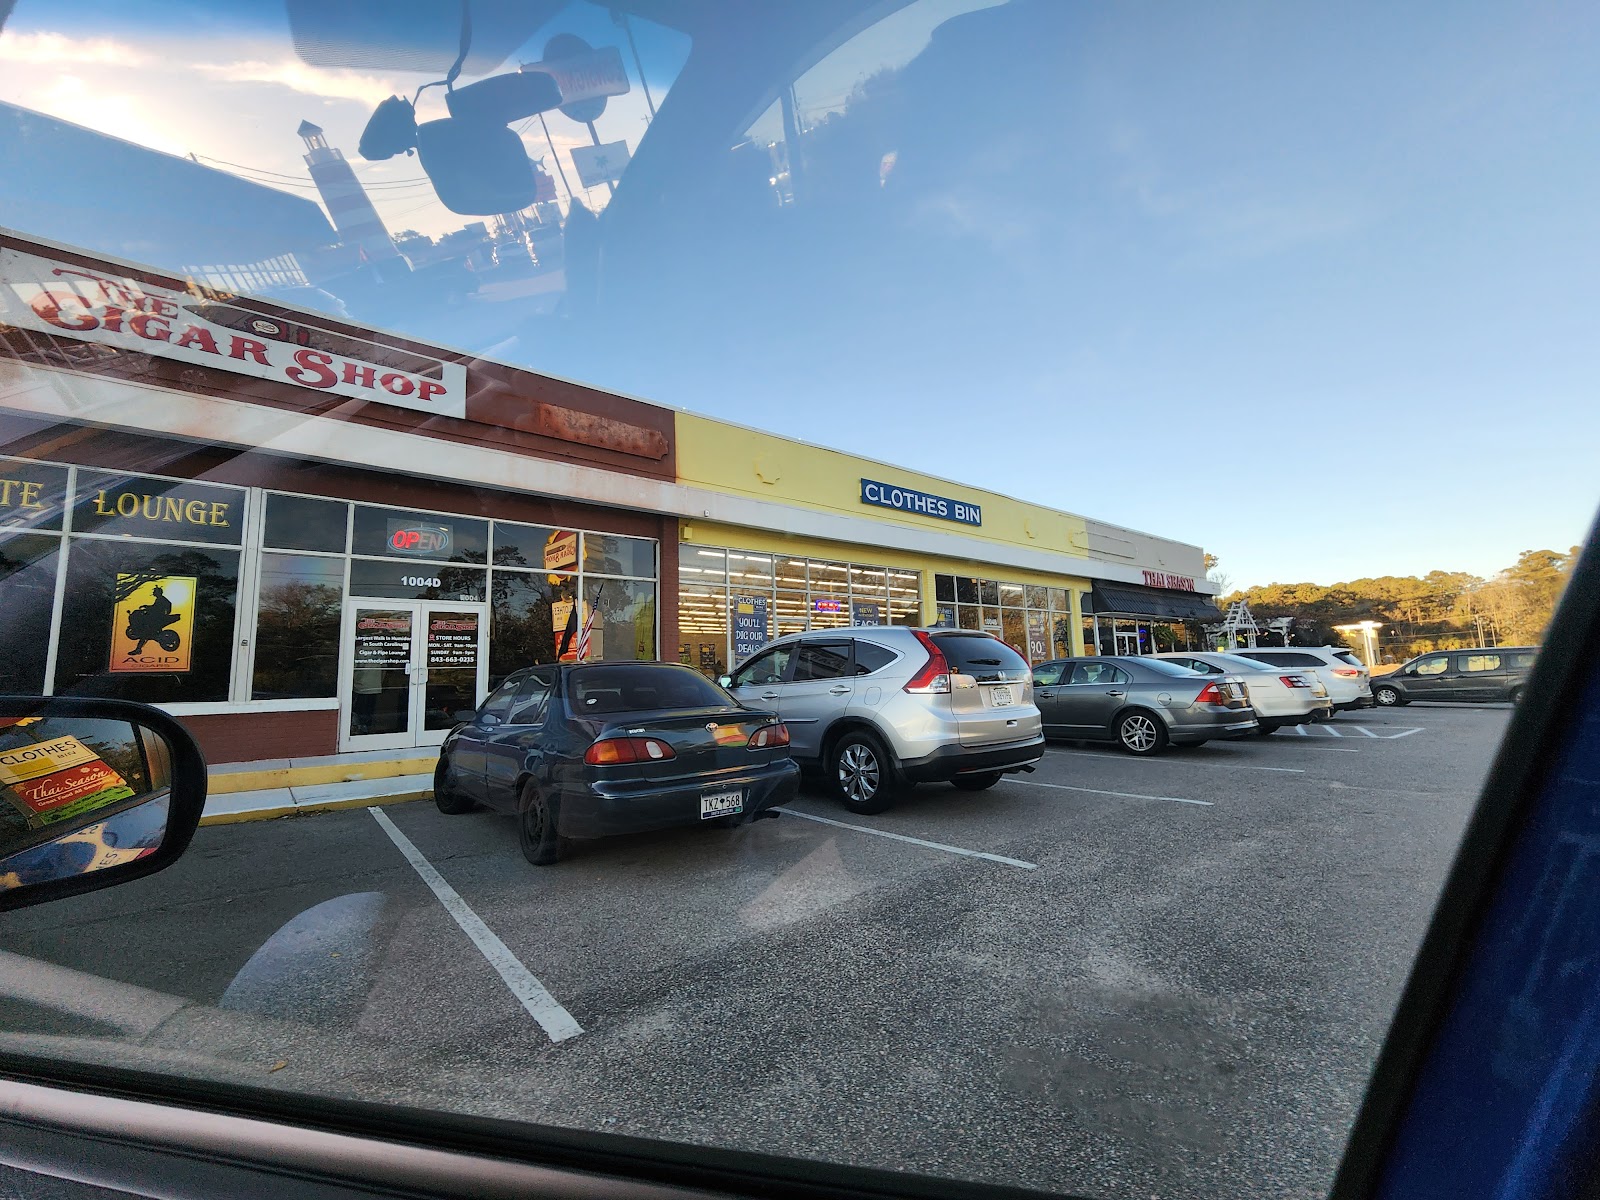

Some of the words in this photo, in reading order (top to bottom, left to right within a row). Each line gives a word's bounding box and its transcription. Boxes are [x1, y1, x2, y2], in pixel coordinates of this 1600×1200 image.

[52, 268, 179, 320] THE
[31, 290, 275, 368] CIGAR
[285, 349, 448, 402] SHOP
[0, 479, 44, 510] TE
[95, 489, 230, 528] LOUNGE
[865, 483, 948, 517] CLOTHES
[954, 503, 981, 524] BIN
[392, 530, 443, 552] OPEN
[401, 575, 442, 588] 1004D
[1142, 570, 1166, 588] THAI
[1166, 574, 1195, 592] SEASON
[738, 597, 766, 606] CLOTHES
[739, 617, 761, 628] YOU'LL
[736, 630, 749, 641] DIG
[749, 631, 764, 641] OUR
[738, 643, 761, 653] DEALS
[1030, 641, 1043, 654] 90
[0, 740, 77, 766] CLOTHES
[26, 779, 65, 801] Thai
[63, 769, 110, 791] Season
[704, 797, 719, 812] TKZ
[726, 794, 740, 808] 568
